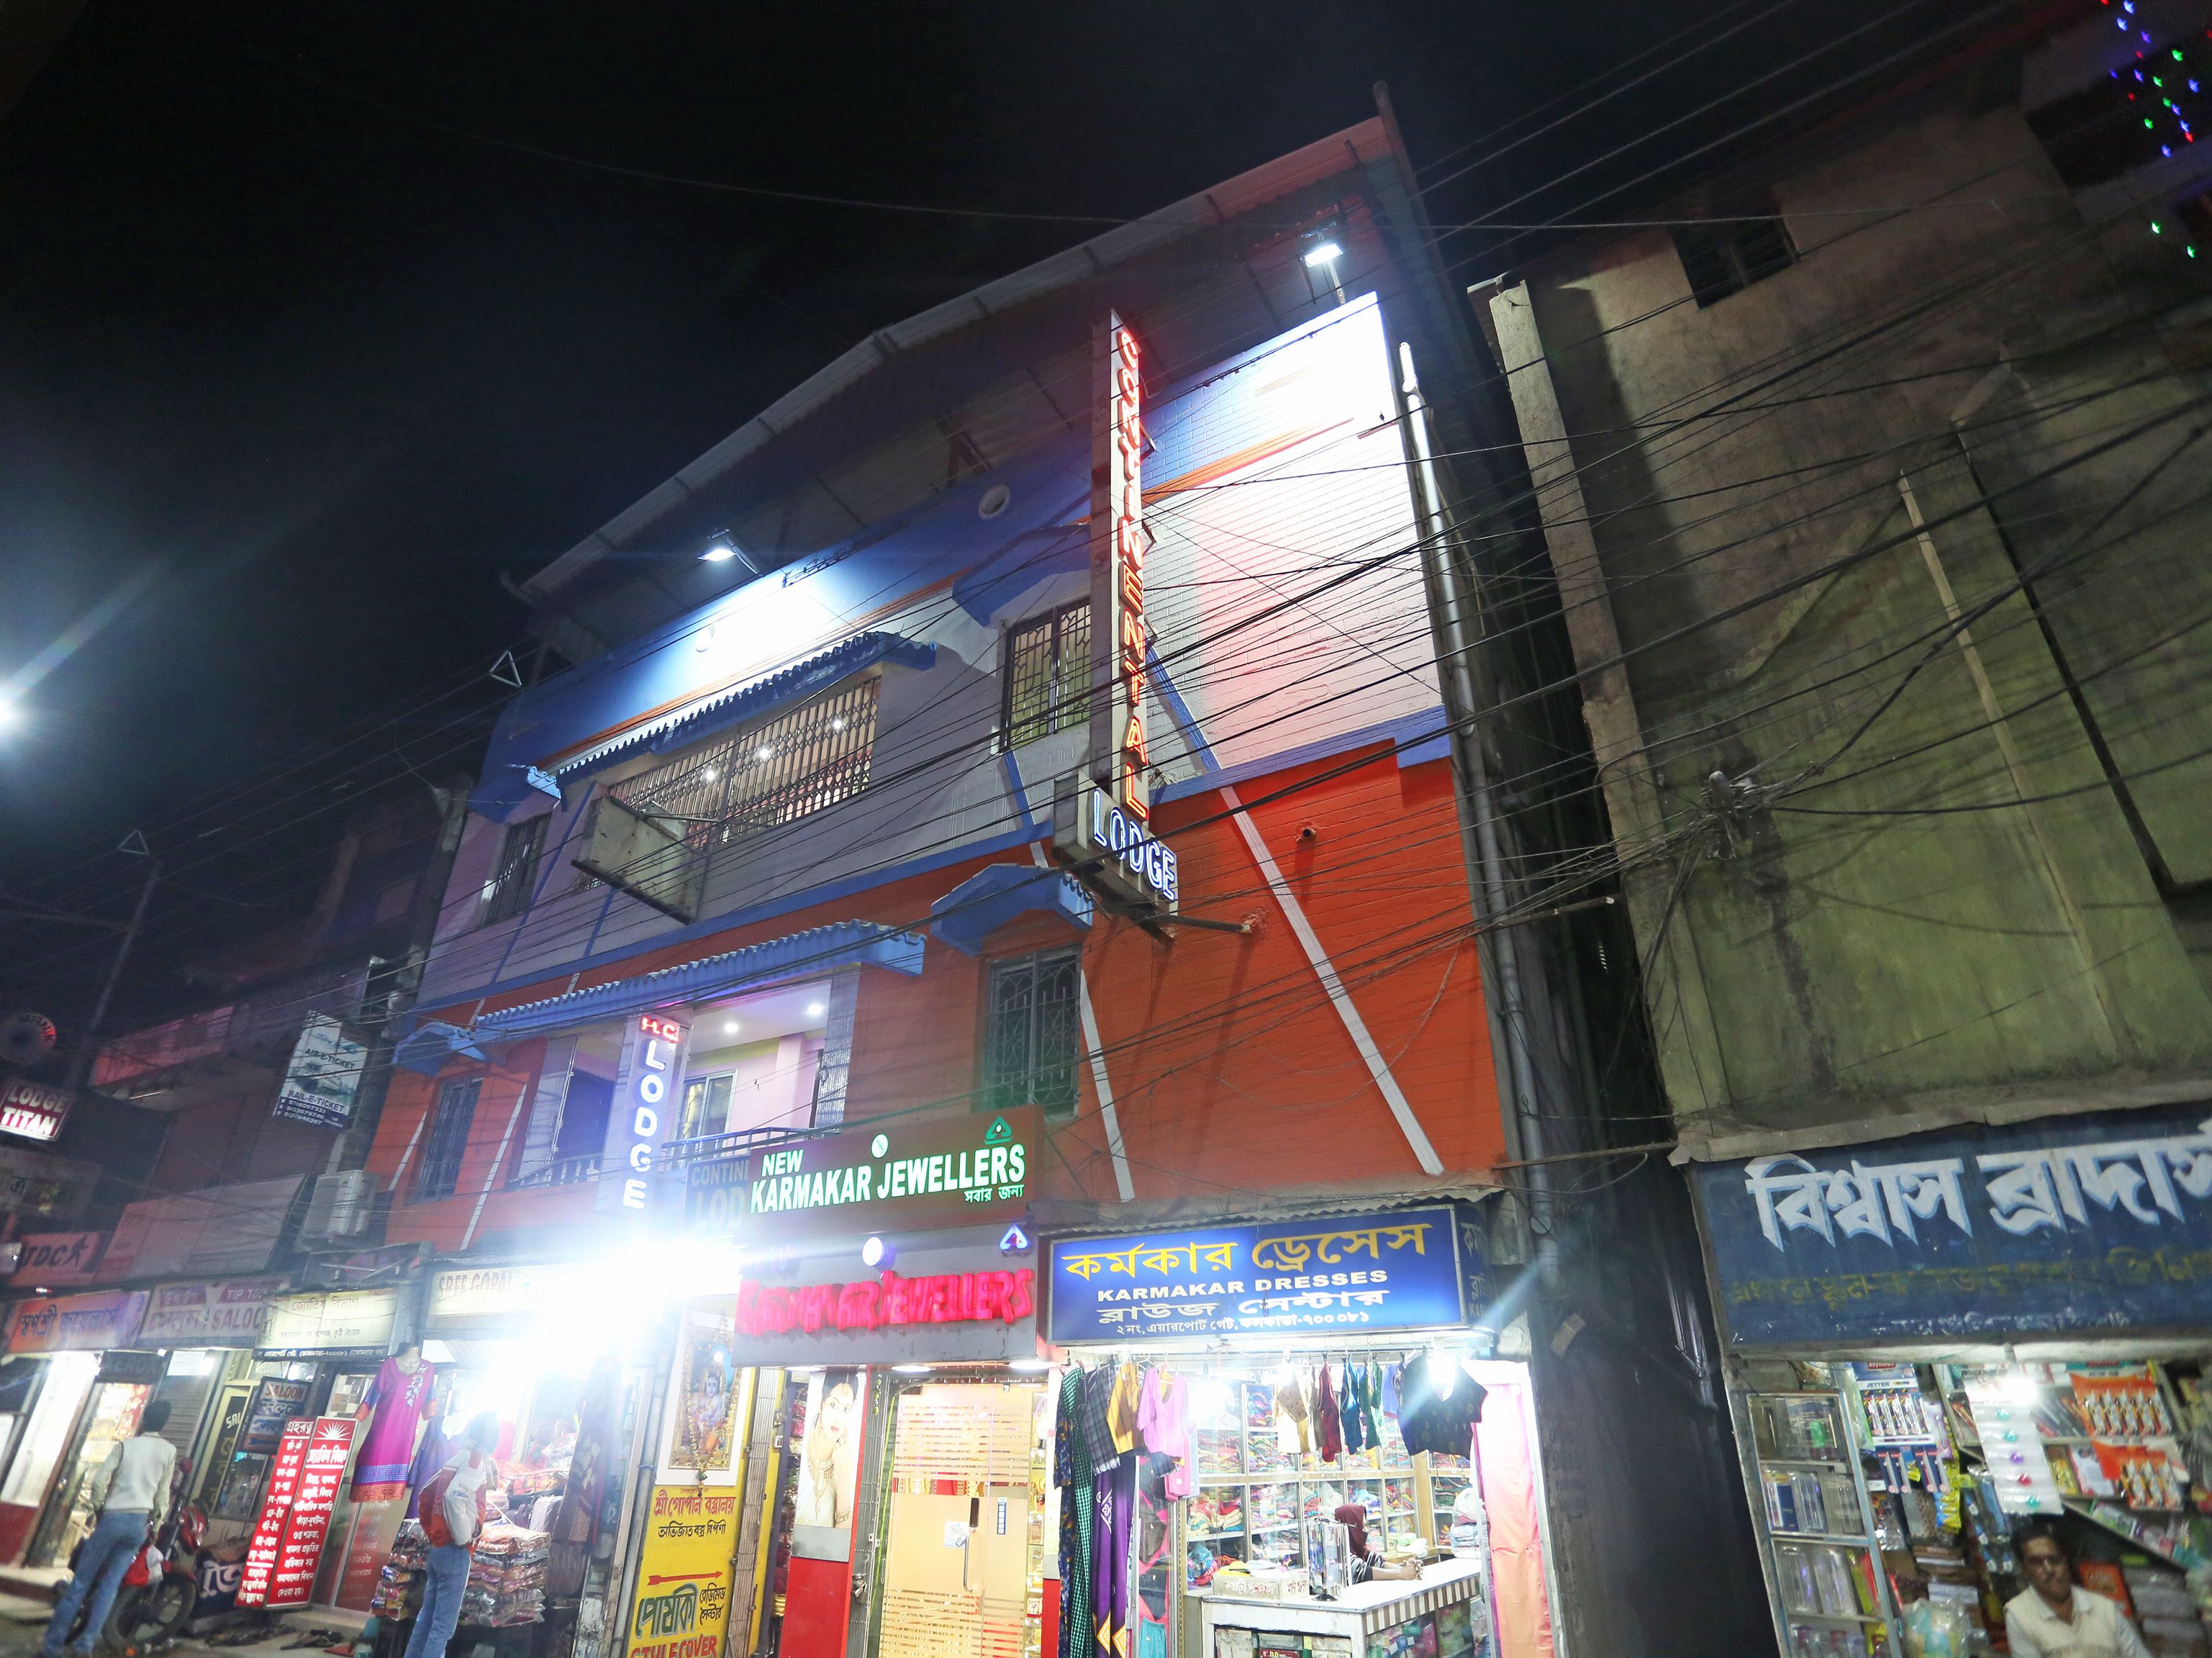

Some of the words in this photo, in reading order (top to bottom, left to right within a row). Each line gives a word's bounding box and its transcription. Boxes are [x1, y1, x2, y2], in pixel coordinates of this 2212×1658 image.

[1117, 330, 1149, 820] CONTINENTAL
[1093, 789, 1176, 902] LODGE
[305, 1048, 355, 1069] AIR-E-TICKET
[7, 1084, 65, 1114] LODGE
[288, 1090, 345, 1113] RAIL-E-TICKET
[1, 1107, 57, 1136] TITAN
[622, 1039, 666, 1210] LODGE
[761, 1150, 804, 1177] NEW
[750, 1165, 872, 1214] KARMAKAR
[876, 1143, 1025, 1200] JEWELLERS
[964, 1188, 992, 1203] সবার
[998, 1184, 1025, 1200] জন্য
[1745, 1152, 1973, 1252] বিশ্বাস
[1062, 1242, 1238, 1281] কর্মকার
[1251, 1223, 1433, 1272] ড্রেসেস
[226, 1290, 243, 1300] TIP
[879, 1269, 1034, 1324] JEWELLERS
[1097, 1281, 1245, 1302] KARMAKAR
[1254, 1269, 1389, 1291] DRESSES
[330, 1295, 359, 1310] বিভাগ
[1097, 1302, 1220, 1323] ব্লাউজ
[1238, 1290, 1390, 1315] সেন্টার
[264, 1383, 305, 1401] SALOON
[658, 1520, 694, 1539] অভিজাত
[699, 1582, 727, 1605] রেডিমেড
